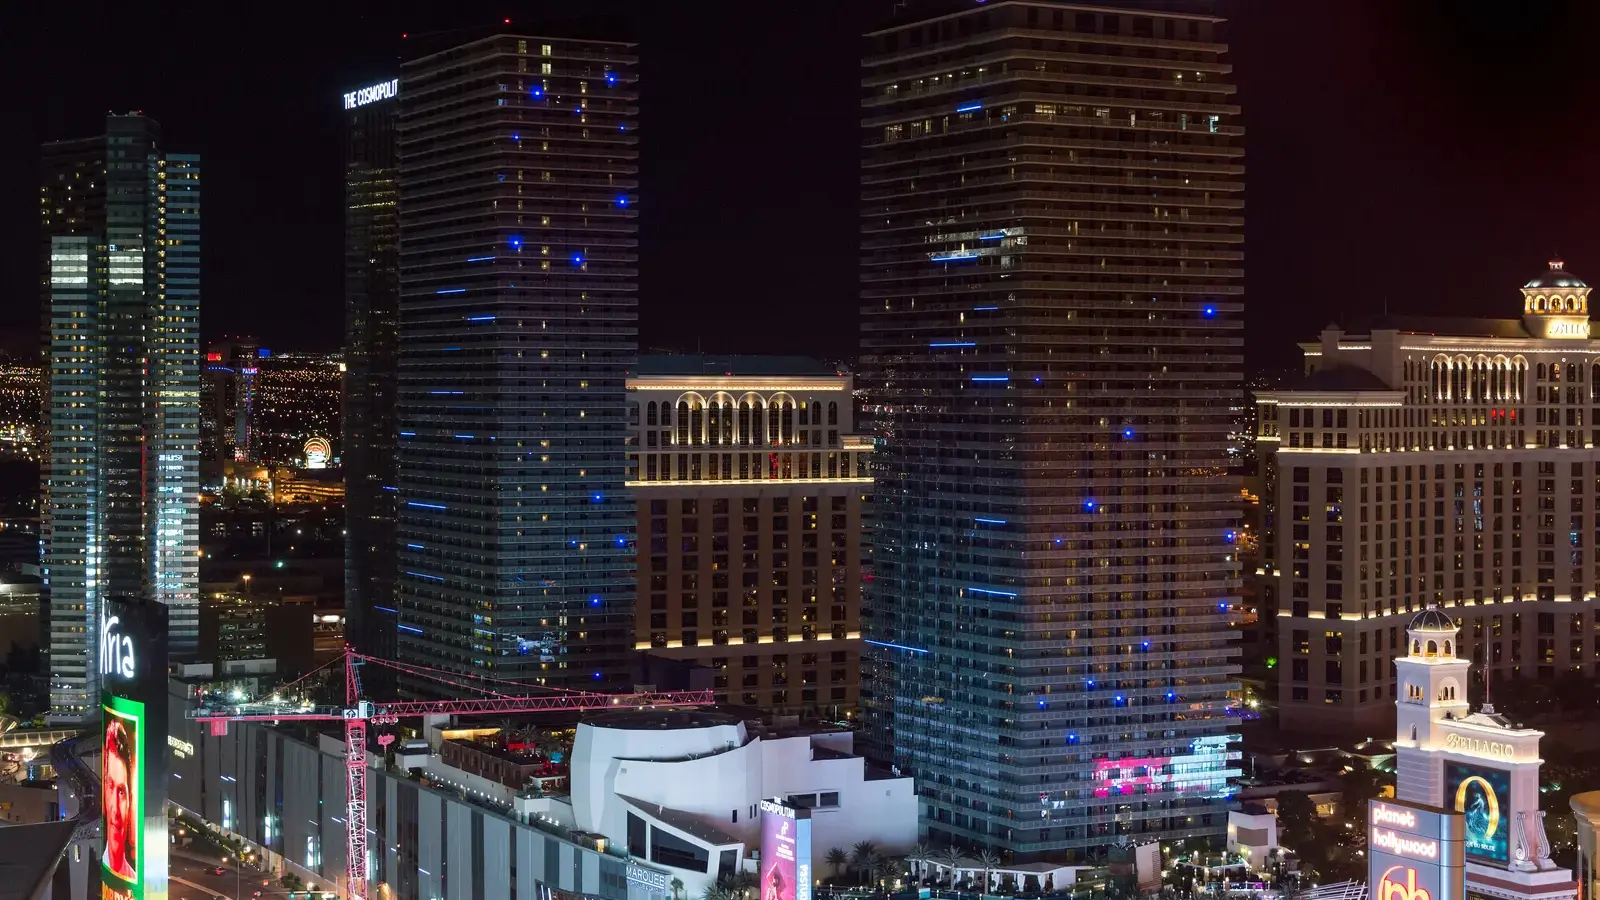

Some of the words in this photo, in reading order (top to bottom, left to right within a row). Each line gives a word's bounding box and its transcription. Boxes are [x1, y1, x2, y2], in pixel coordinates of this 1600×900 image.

[343, 91, 357, 110] THE
[357, 78, 398, 106] COSMOPOLIT
[242, 367, 258, 375] PALMS
[1446, 733, 1514, 757] BELLAGIO
[760, 799, 796, 820] COSMOPOLITAN
[773, 796, 782, 804] THE
[1372, 804, 1415, 827] planet
[1372, 828, 1436, 858] hollywood
[626, 865, 665, 887] MARQUEE
